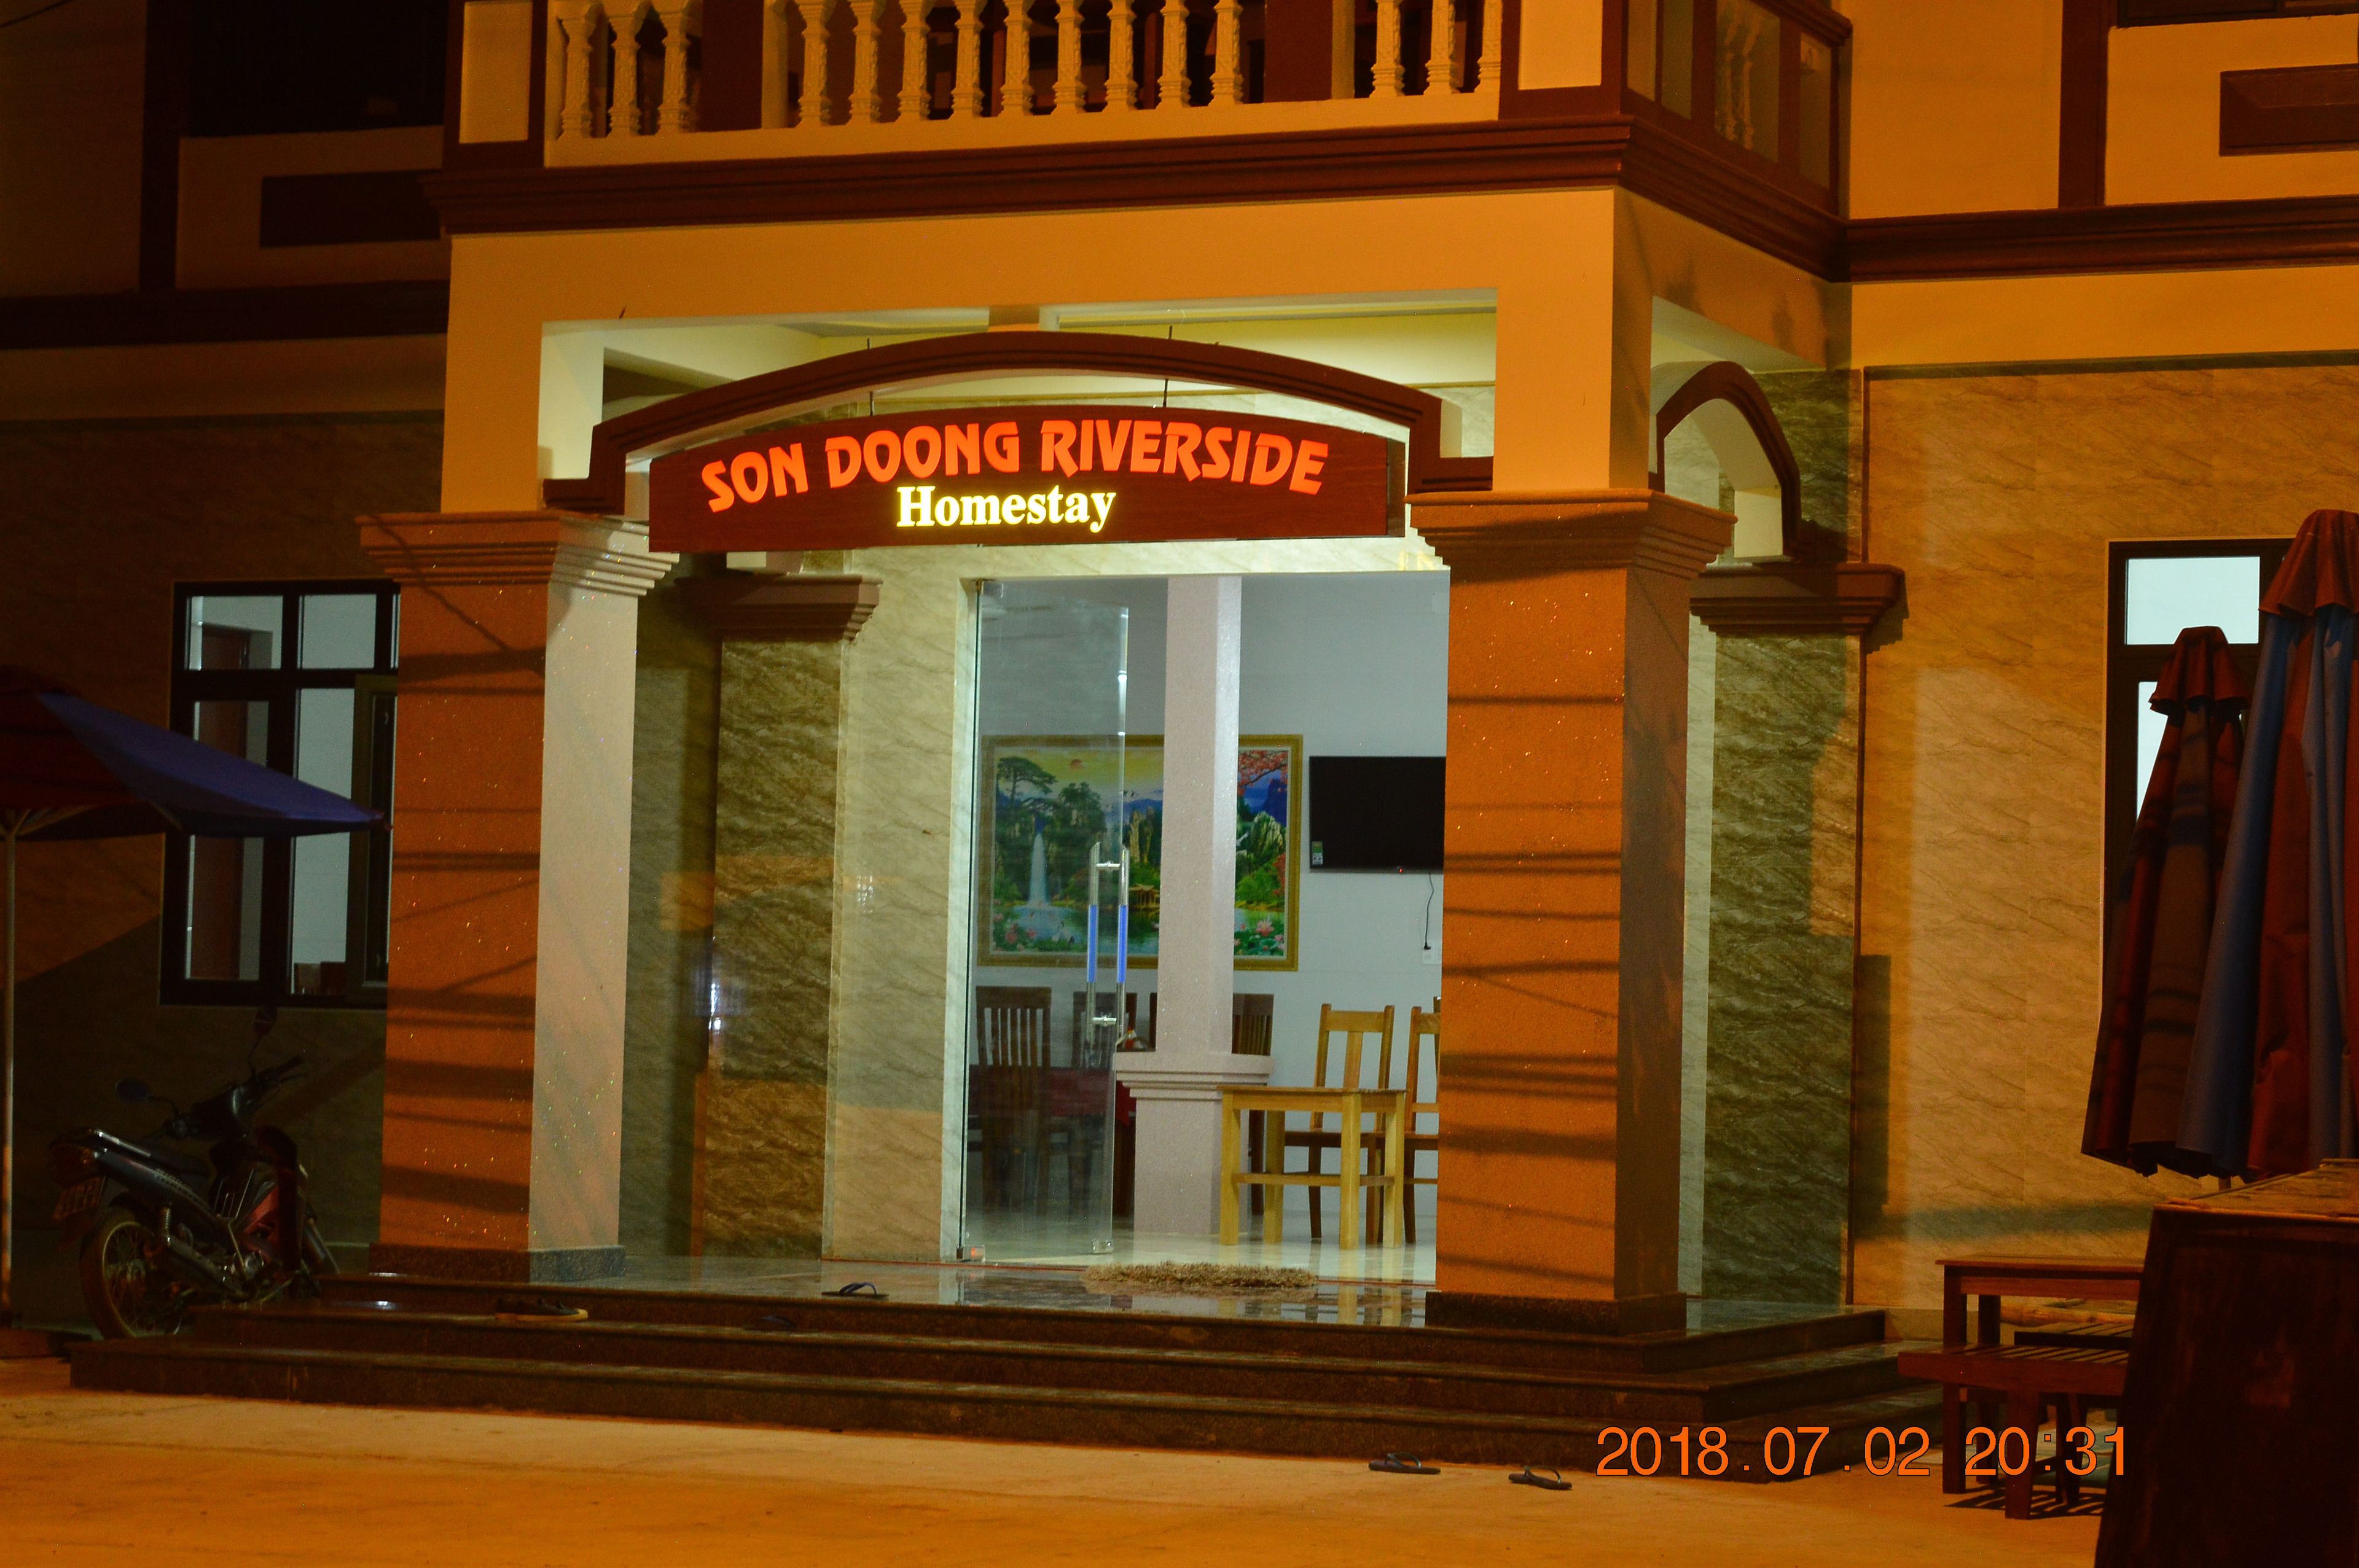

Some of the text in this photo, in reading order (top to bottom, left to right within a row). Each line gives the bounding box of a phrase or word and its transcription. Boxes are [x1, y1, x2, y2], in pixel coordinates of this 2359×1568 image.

[702, 419, 1329, 513] SON DOONG RIVERSIDE
[896, 485, 1117, 534] Homestay
